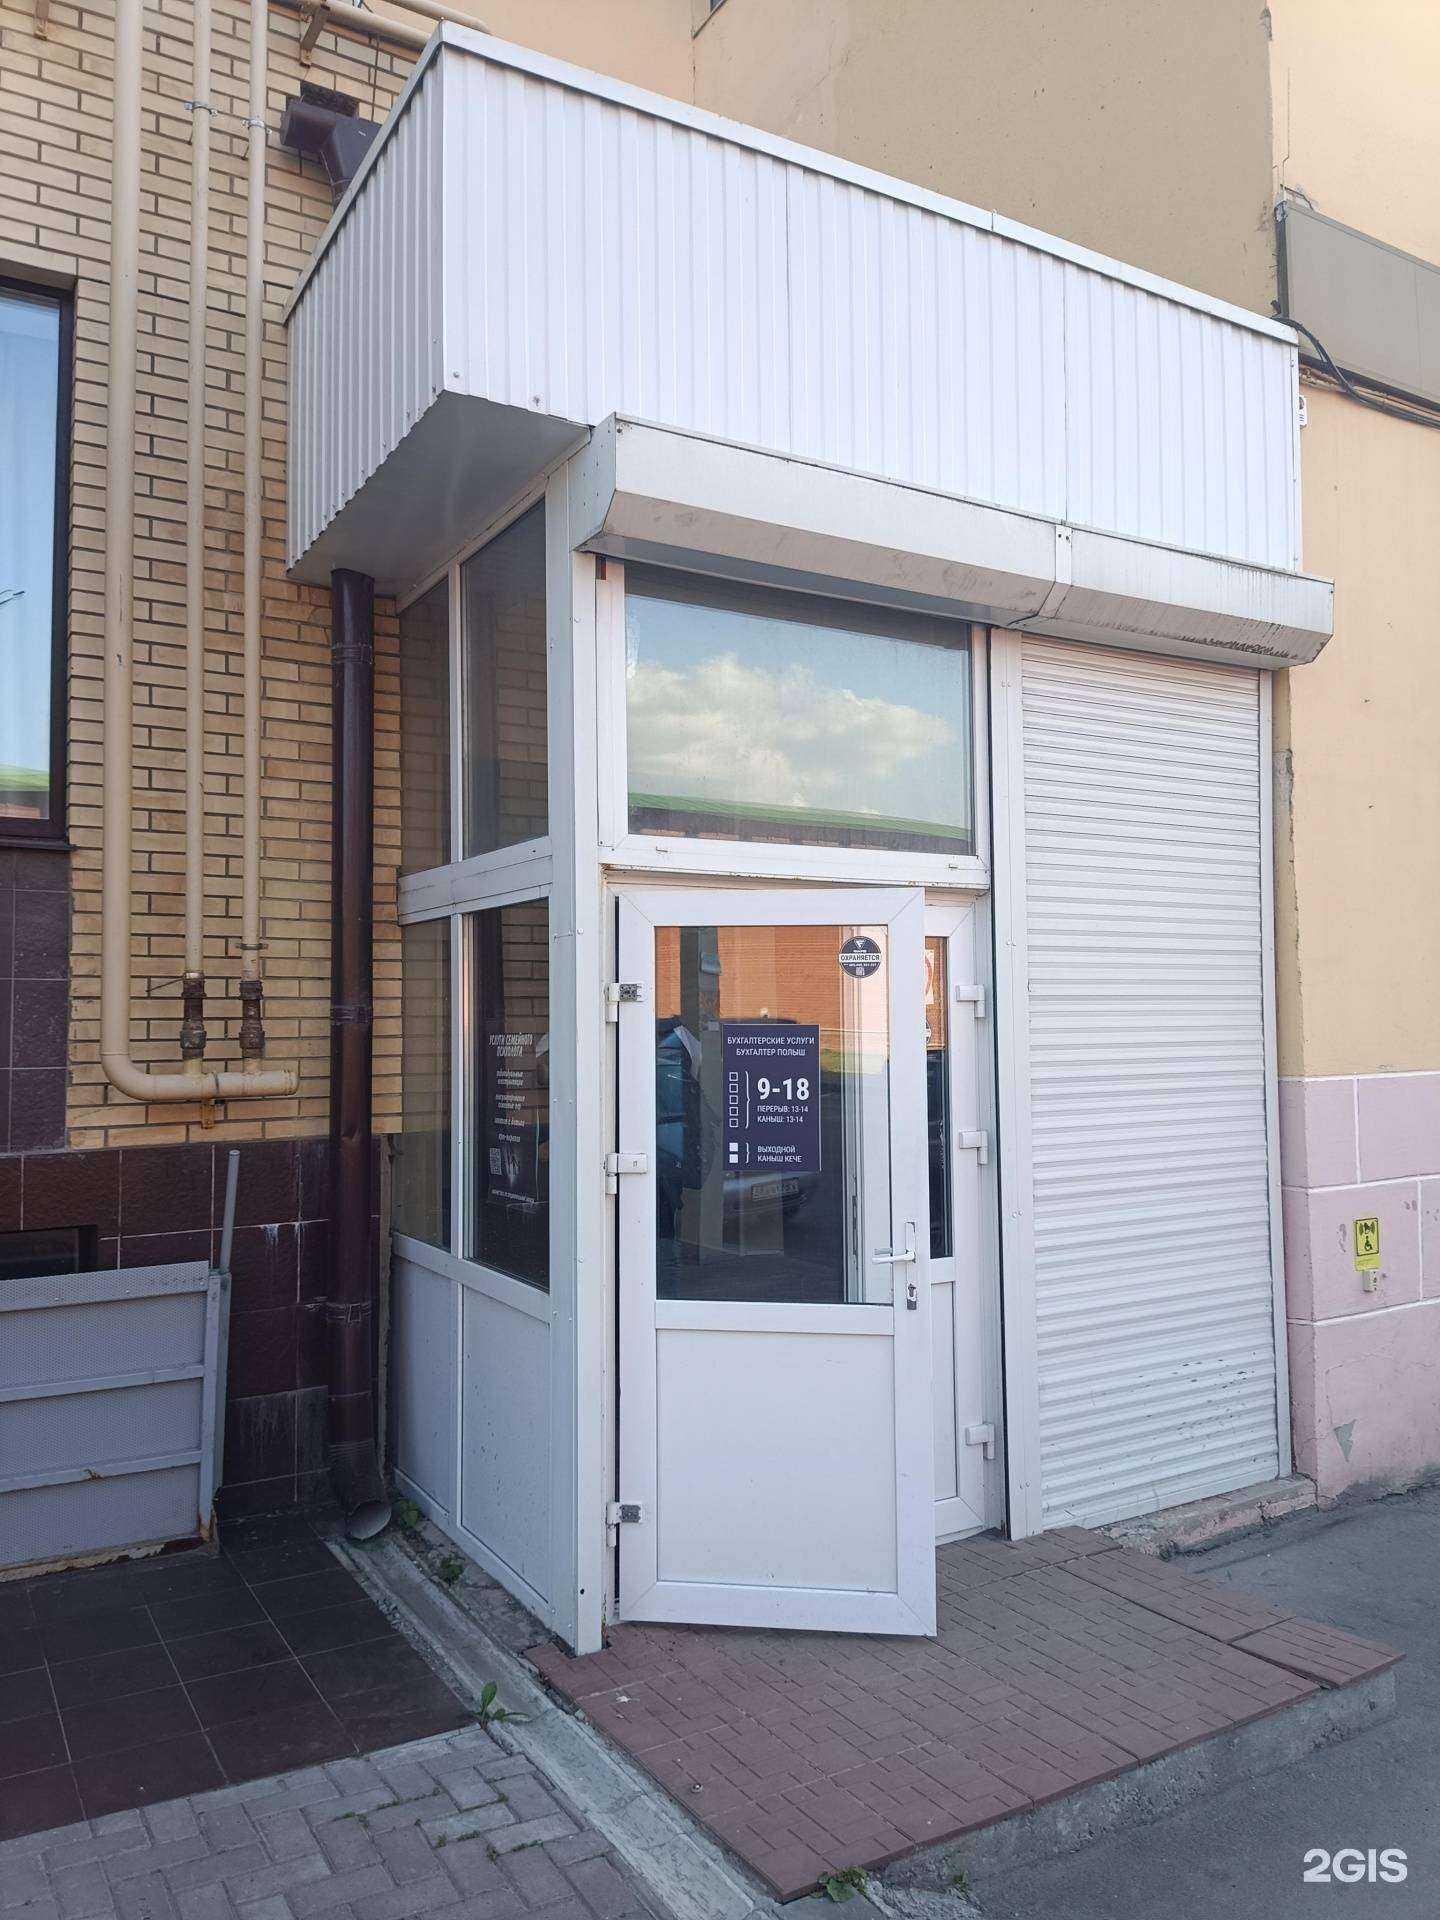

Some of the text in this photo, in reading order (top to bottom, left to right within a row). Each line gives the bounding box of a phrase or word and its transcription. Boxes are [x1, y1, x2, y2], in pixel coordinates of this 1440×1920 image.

[727, 1036, 815, 1045] БУХГАЛТЕРСКИЕ УСЛУГИ
[736, 1048, 806, 1056] БУХГАЛТЕР ПОЛЫШ
[757, 1077, 810, 1101] 9-18
[757, 1105, 809, 1113] ПЕРЕРЫВ: 13-14
[757, 1115, 804, 1123] КАНЫШ: 13-14
[757, 1145, 796, 1153] ВЫХОДНОЙ
[784, 1155, 803, 1163] КЕЧЕ
